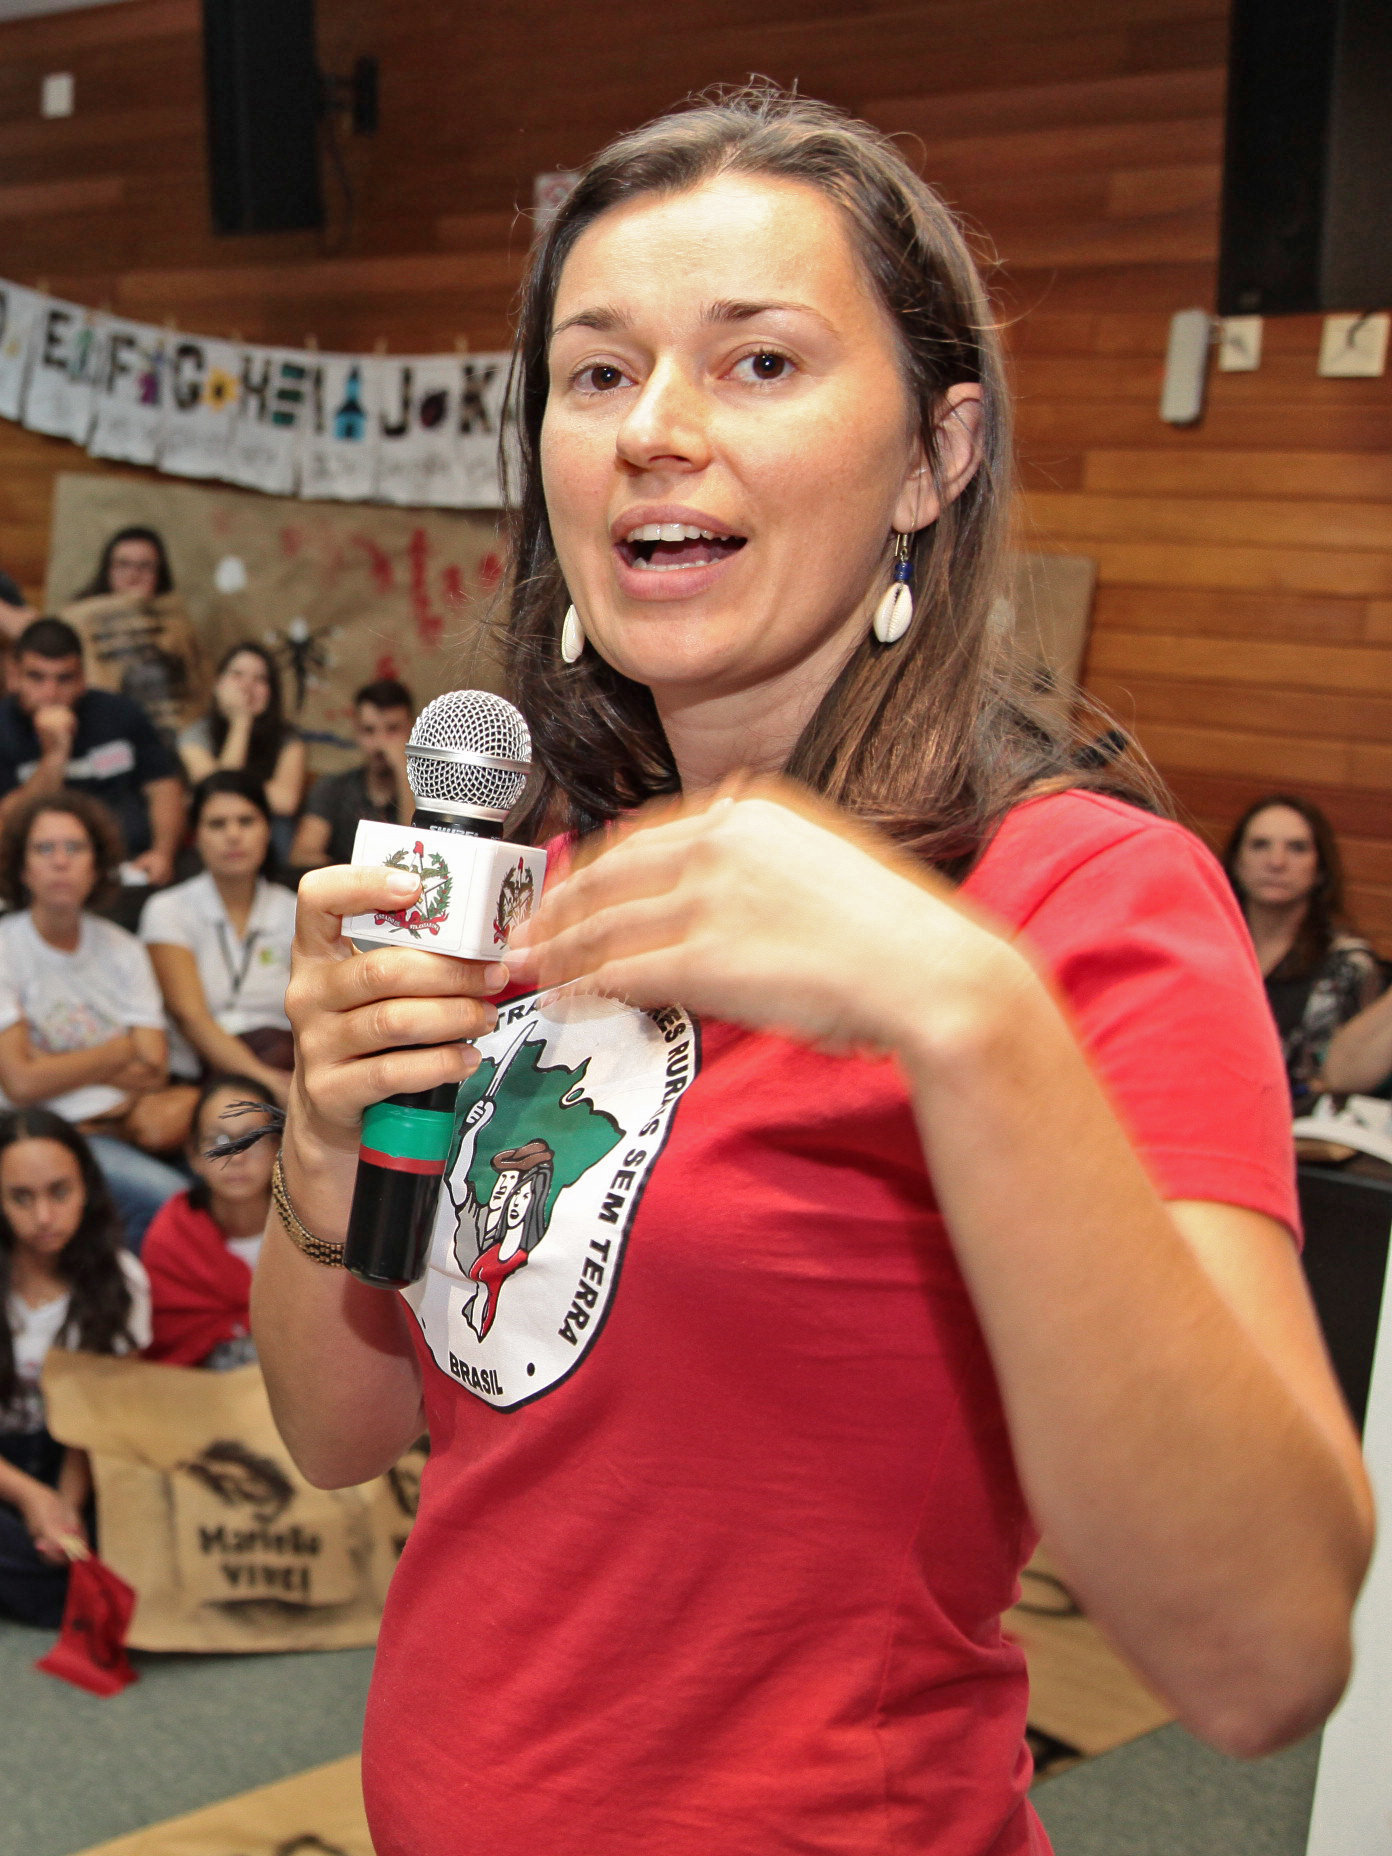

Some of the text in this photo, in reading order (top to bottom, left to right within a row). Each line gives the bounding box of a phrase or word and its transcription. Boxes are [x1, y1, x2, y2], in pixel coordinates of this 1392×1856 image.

[43, 308, 71, 369] E
[108, 331, 137, 394] F
[172, 343, 204, 412] G
[380, 365, 414, 438] J
[638, 1040, 690, 1137] RURS
[598, 1148, 647, 1225] SEM
[558, 1239, 611, 1346] TERRA
[449, 1351, 503, 1396] BRASIL
